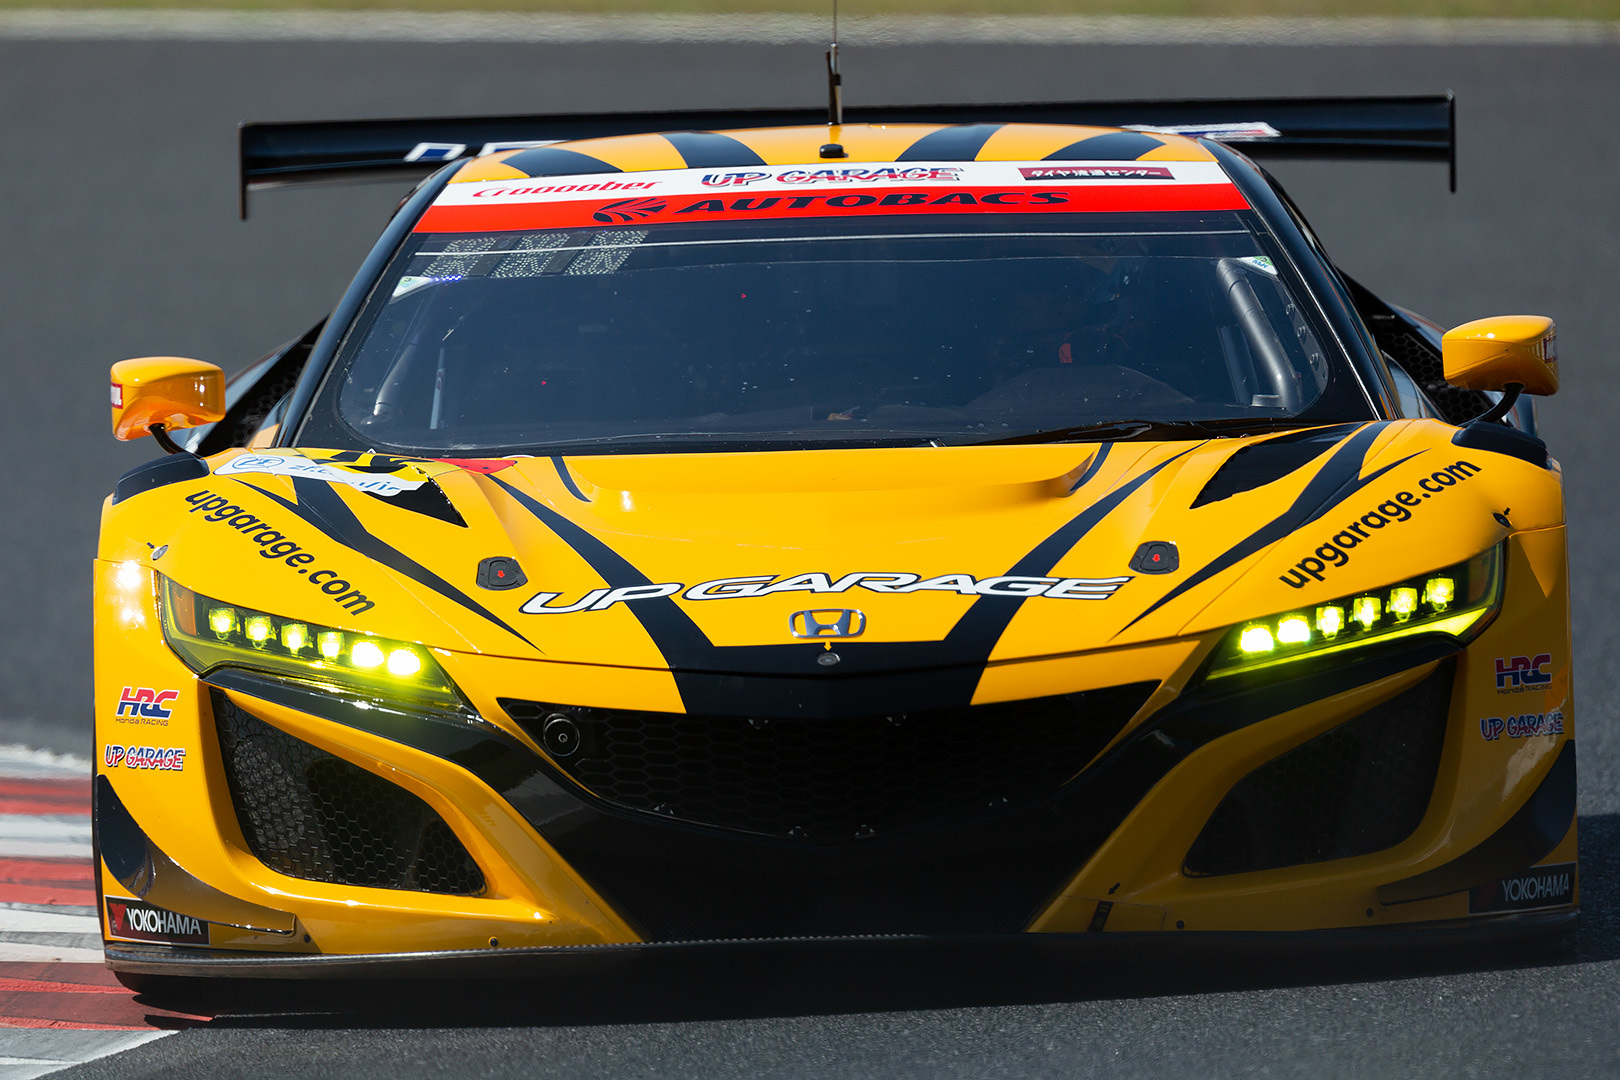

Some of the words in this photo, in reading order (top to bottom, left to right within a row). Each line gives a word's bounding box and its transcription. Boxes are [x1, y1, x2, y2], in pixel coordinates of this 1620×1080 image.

[472, 181, 664, 198] Croooober
[701, 171, 772, 187] UP
[776, 167, 965, 184] GARAGE
[672, 191, 1070, 214] AUTOBACS
[1279, 460, 1482, 589] upgarage.com
[185, 490, 375, 616] upgarage.com
[518, 583, 685, 614] UP
[682, 572, 1135, 600] GARAGE
[1495, 653, 1552, 688] HRC
[116, 687, 180, 718] HRC
[140, 719, 169, 727] RACING
[1480, 717, 1505, 741] UP
[1507, 711, 1564, 738] GARAGE
[105, 744, 125, 768] UP
[126, 745, 187, 771] GARAGE
[1502, 873, 1570, 902] YOKOHAMA
[126, 908, 202, 935] YOKOHAMA
